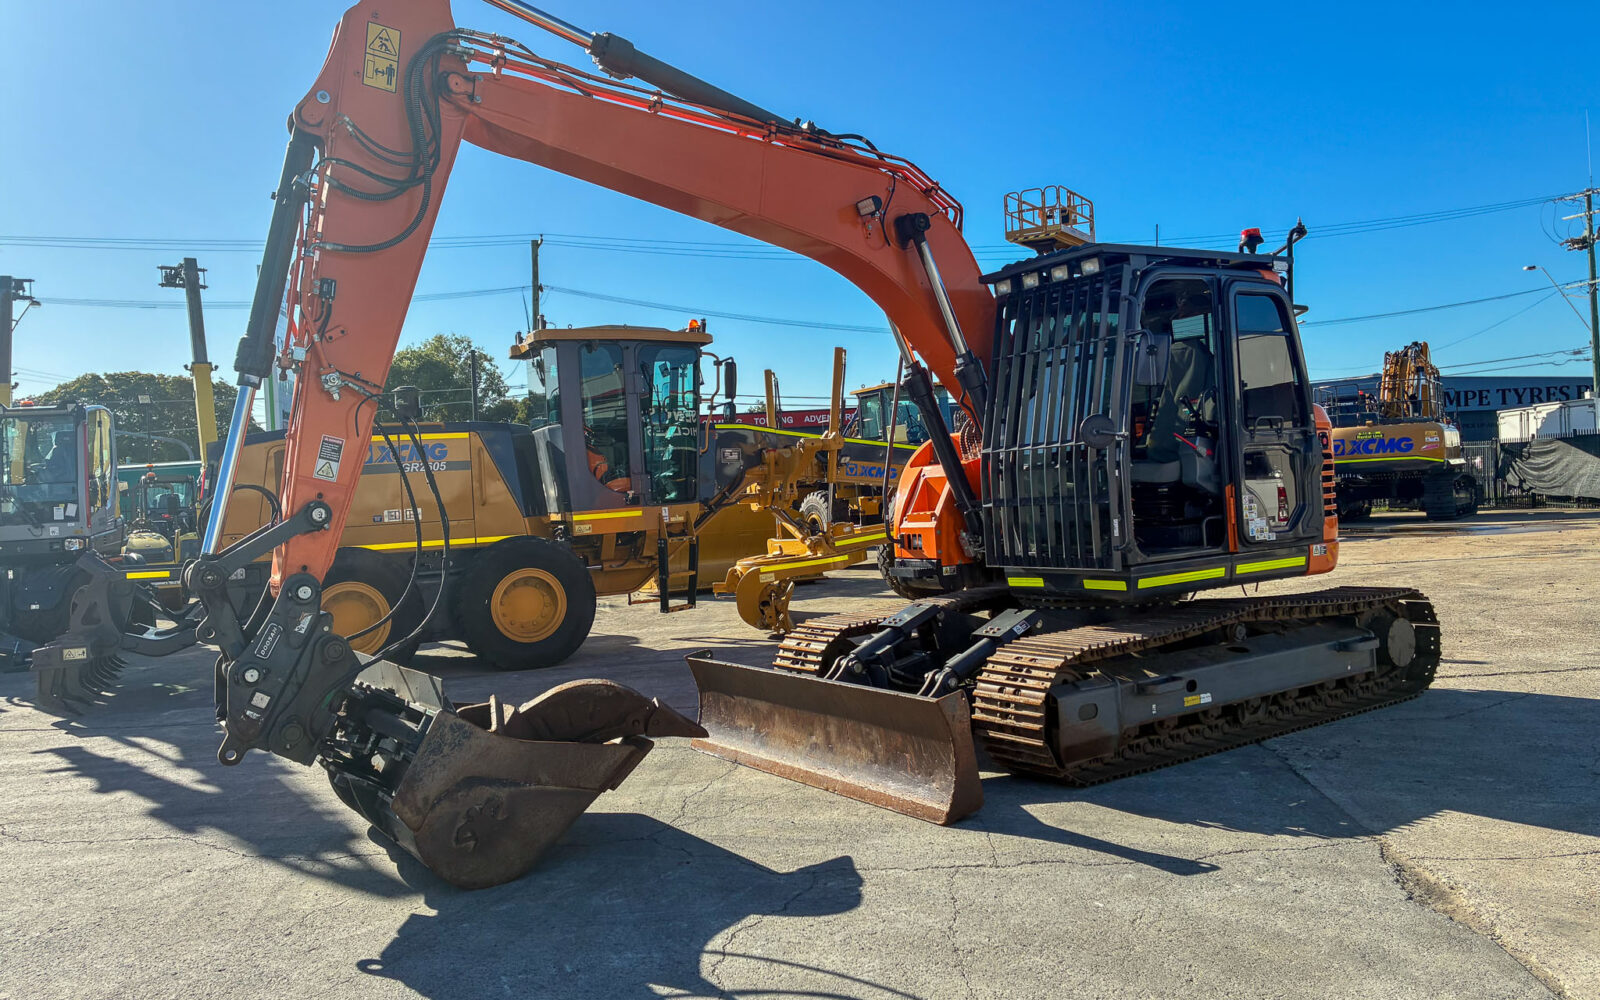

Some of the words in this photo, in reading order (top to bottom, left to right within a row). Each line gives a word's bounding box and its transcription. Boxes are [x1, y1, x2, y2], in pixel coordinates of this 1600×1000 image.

[1496, 385, 1570, 406] TYRES
[375, 442, 449, 463] XCMG
[1346, 436, 1414, 455] XCMG
[859, 465, 898, 480] XCMG
[260, 627, 278, 656] DOOSAN
